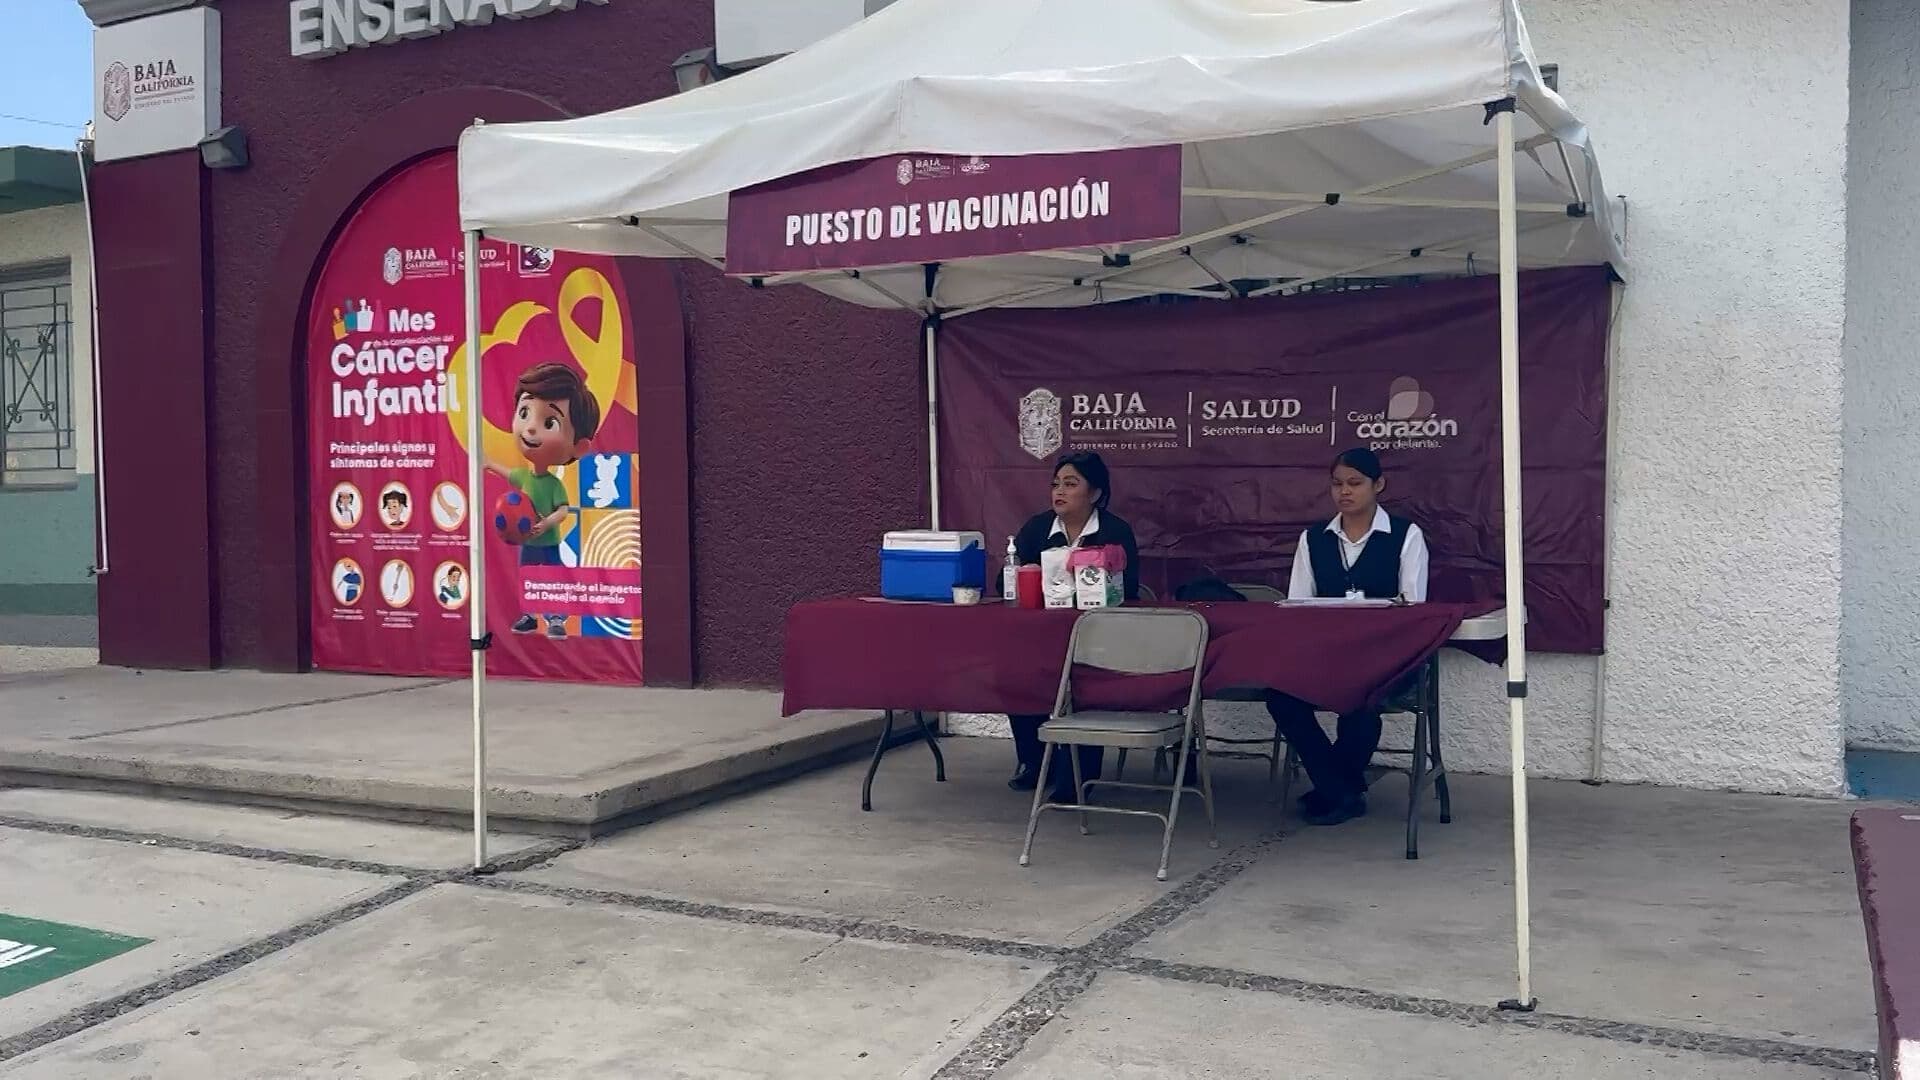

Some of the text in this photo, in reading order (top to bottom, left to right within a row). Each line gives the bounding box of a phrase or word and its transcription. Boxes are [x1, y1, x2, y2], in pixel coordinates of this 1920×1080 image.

[290, 0, 610, 57] ENSEN
[134, 60, 176, 81] BAJA
[134, 76, 194, 94] CALIFORNIA
[785, 177, 1110, 246] PUESTO DE VACUNACIÓN
[405, 249, 437, 262] BAJA
[457, 249, 497, 262] SUD
[388, 308, 436, 333] Mes
[331, 341, 449, 378] Cáncer
[332, 372, 461, 426] Infantil
[1071, 391, 1147, 416] BAJA
[1202, 399, 1300, 420] SALUD
[1347, 411, 1373, 422] Con
[1070, 417, 1177, 431] CALIFORNIA
[1202, 423, 1324, 437] Secretaría de Salud
[1356, 413, 1458, 438] corazón
[330, 440, 436, 456] Principales signos y
[1369, 441, 1391, 452] por
[380, 456, 394, 468] de
